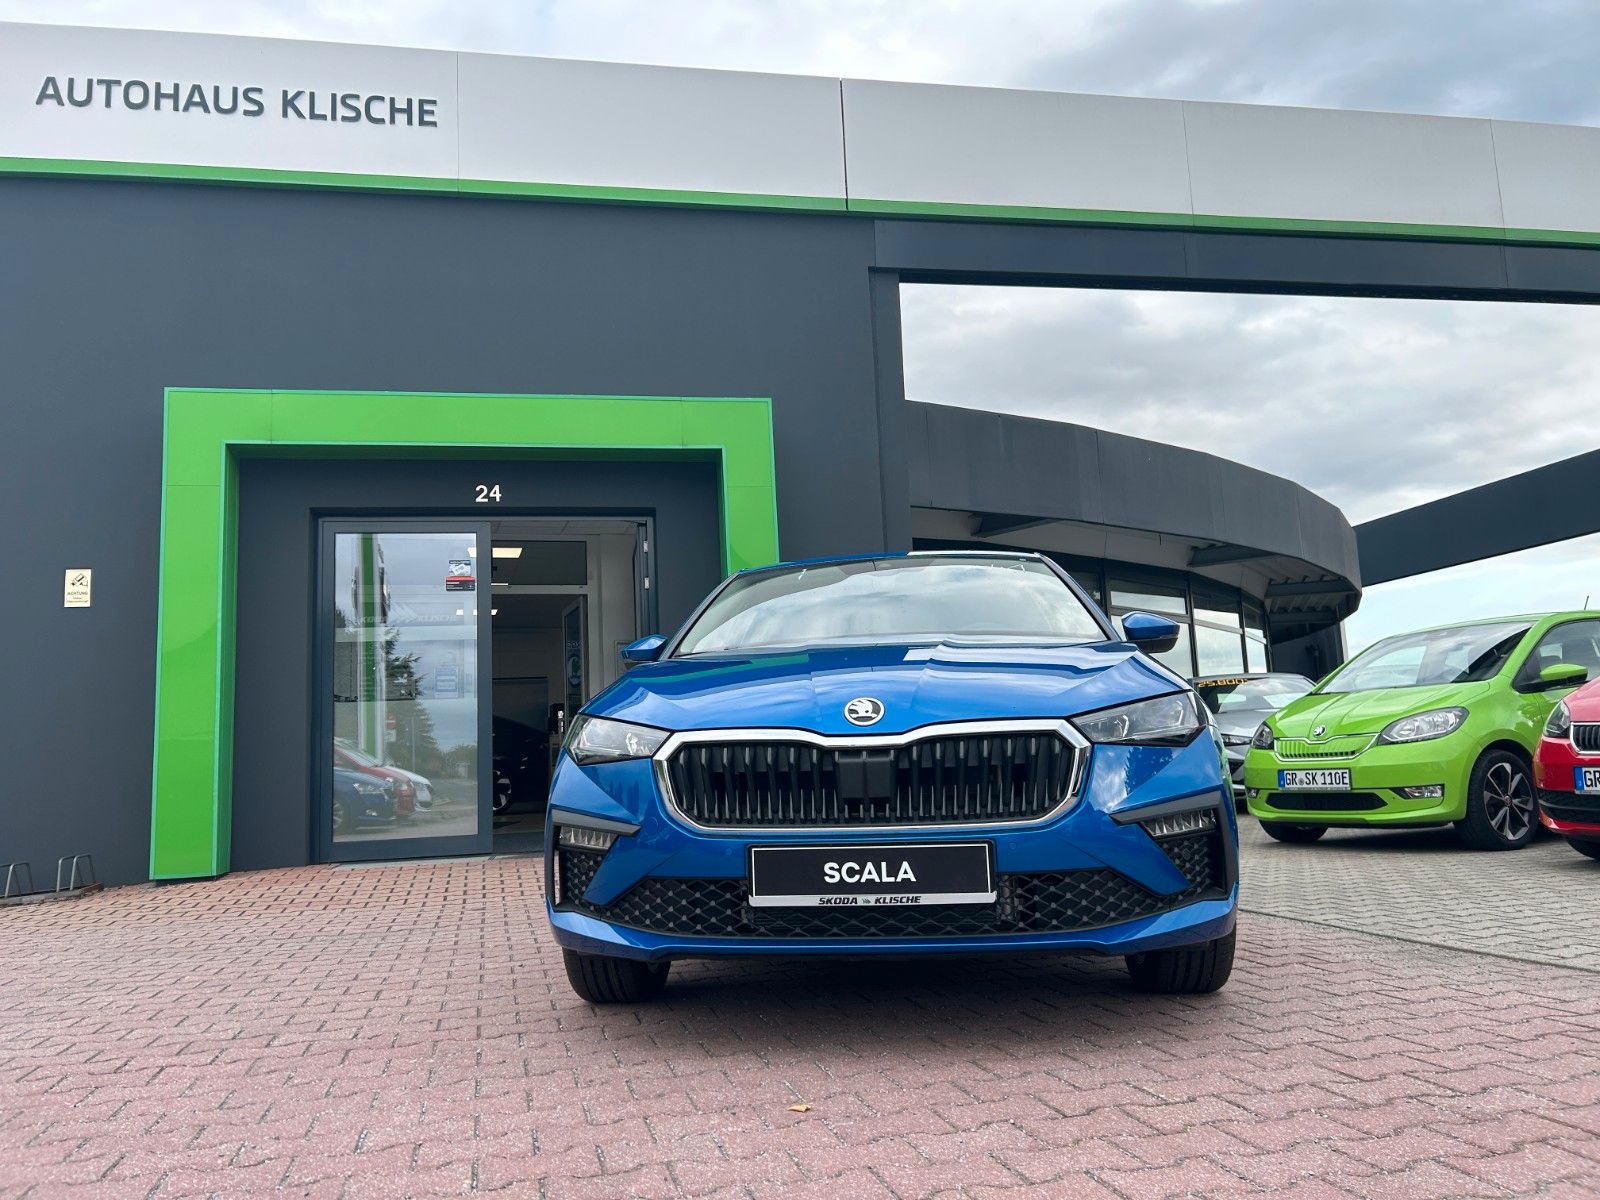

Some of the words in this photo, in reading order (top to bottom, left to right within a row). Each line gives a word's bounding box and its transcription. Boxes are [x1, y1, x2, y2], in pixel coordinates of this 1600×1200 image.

[35, 76, 264, 117] AUTOHAUS
[281, 89, 438, 128] KLISCHE
[475, 484, 502, 503] 24
[1285, 772, 1298, 786] GR
[1305, 771, 1318, 786] SK
[1320, 771, 1349, 786] 110E
[823, 861, 917, 884] SCALA
[874, 895, 922, 905] KLISCHE
